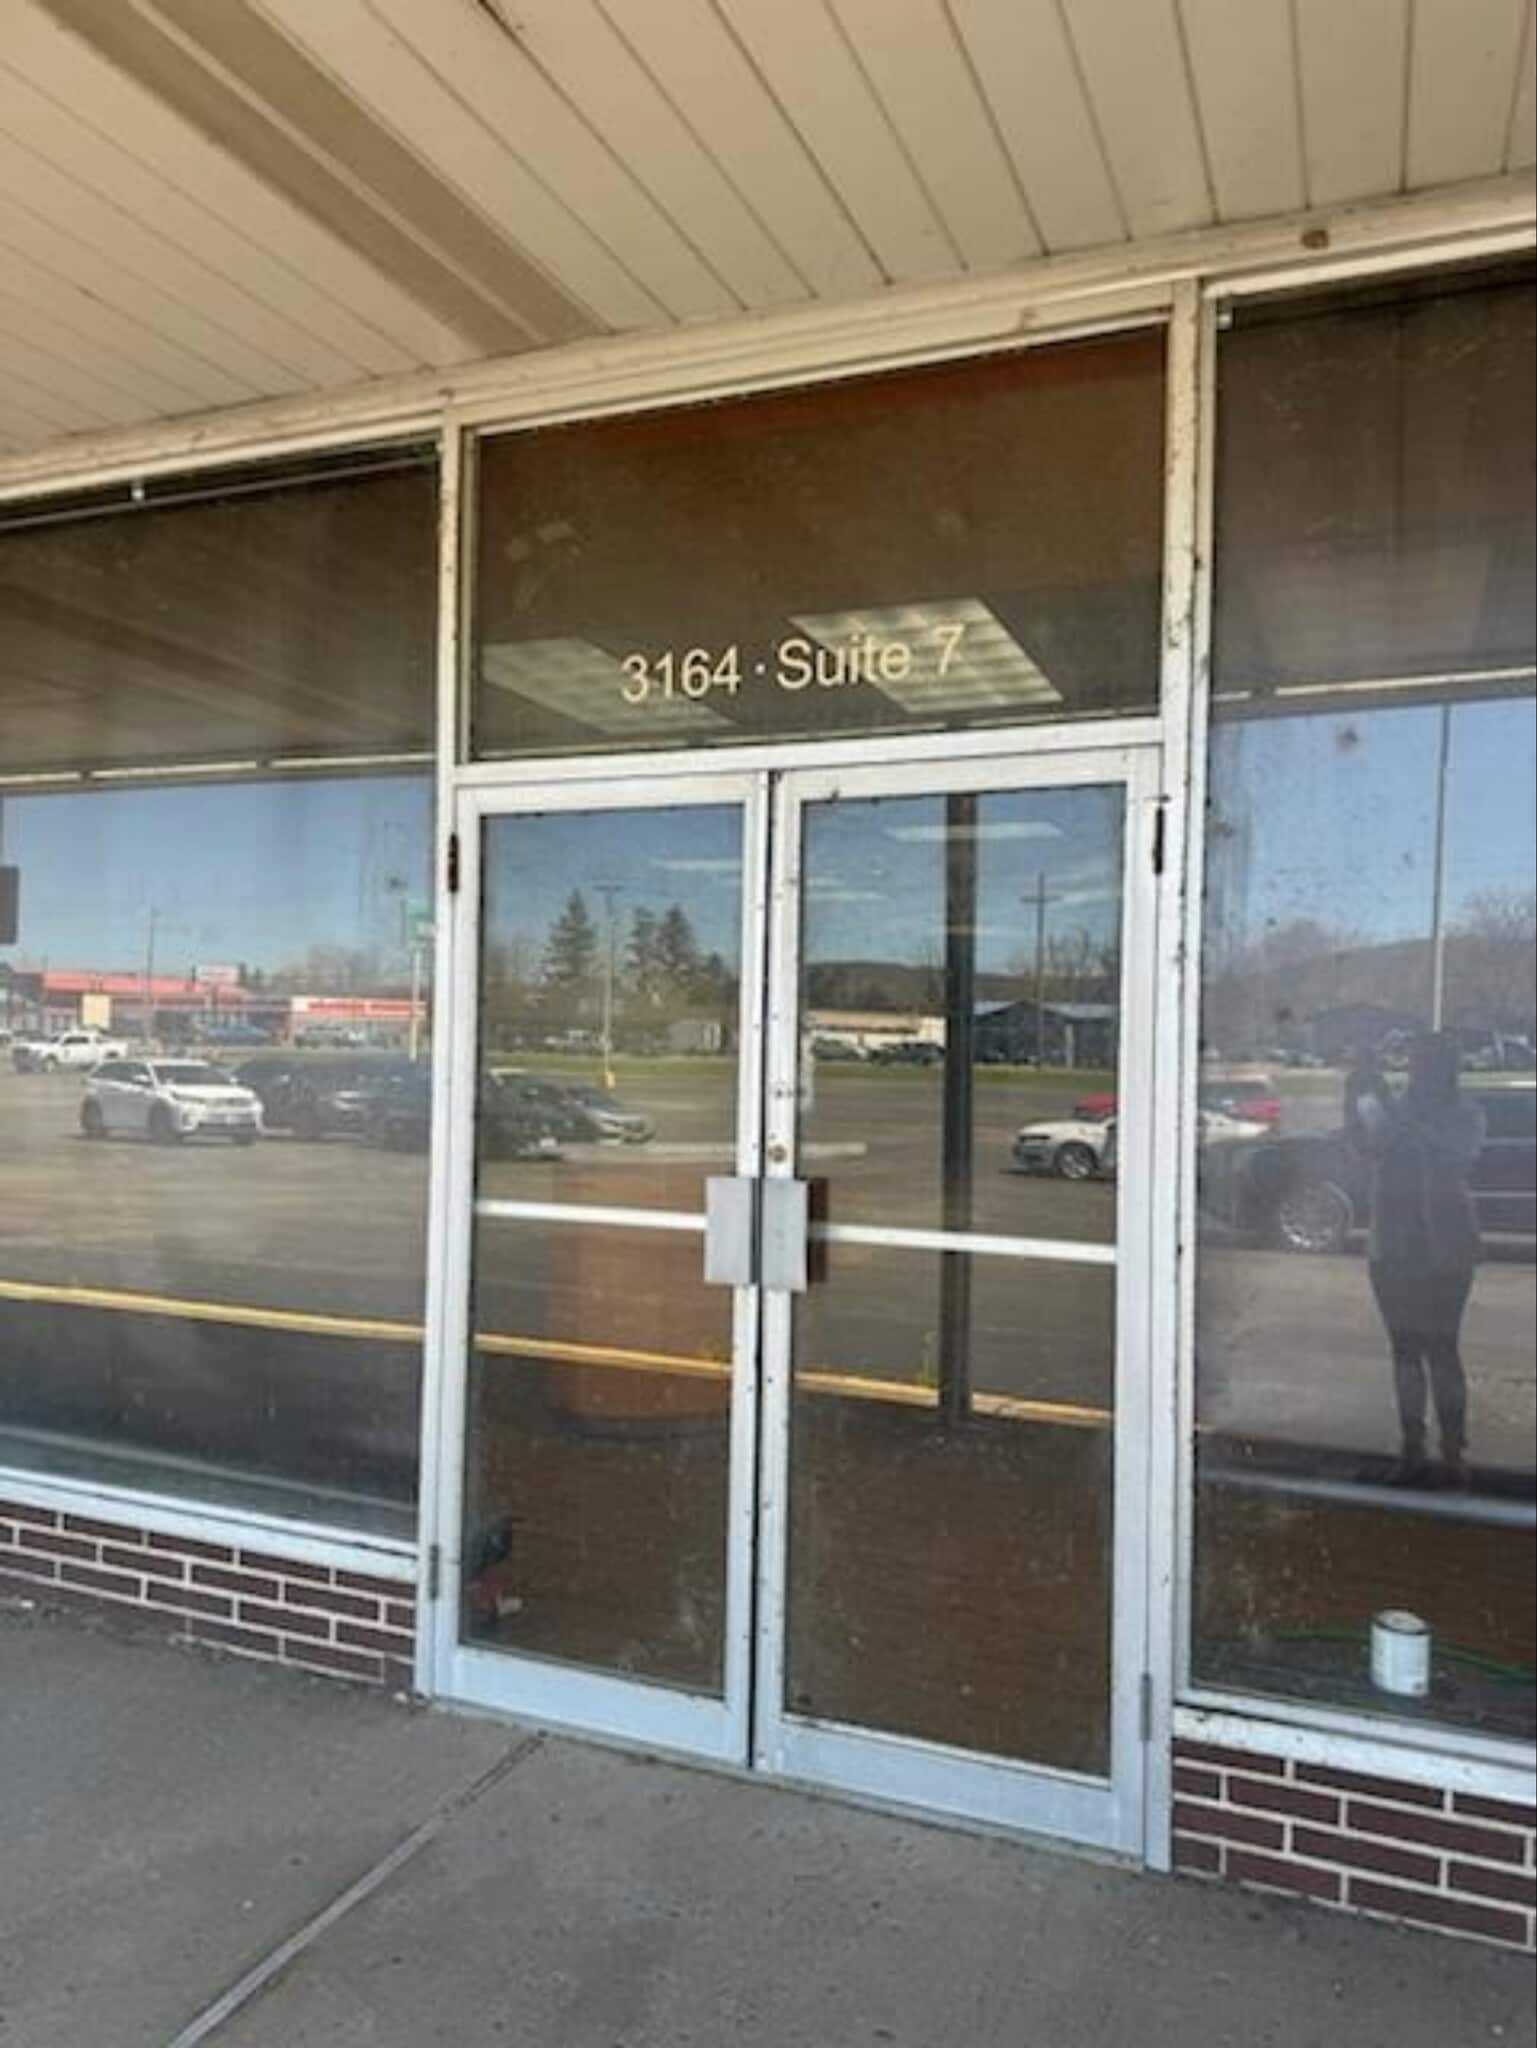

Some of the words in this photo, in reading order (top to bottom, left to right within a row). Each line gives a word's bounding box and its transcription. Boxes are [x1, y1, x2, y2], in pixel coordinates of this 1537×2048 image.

[620, 645, 742, 703] 3164
[777, 633, 911, 689] Suite
[932, 623, 965, 677] 7
